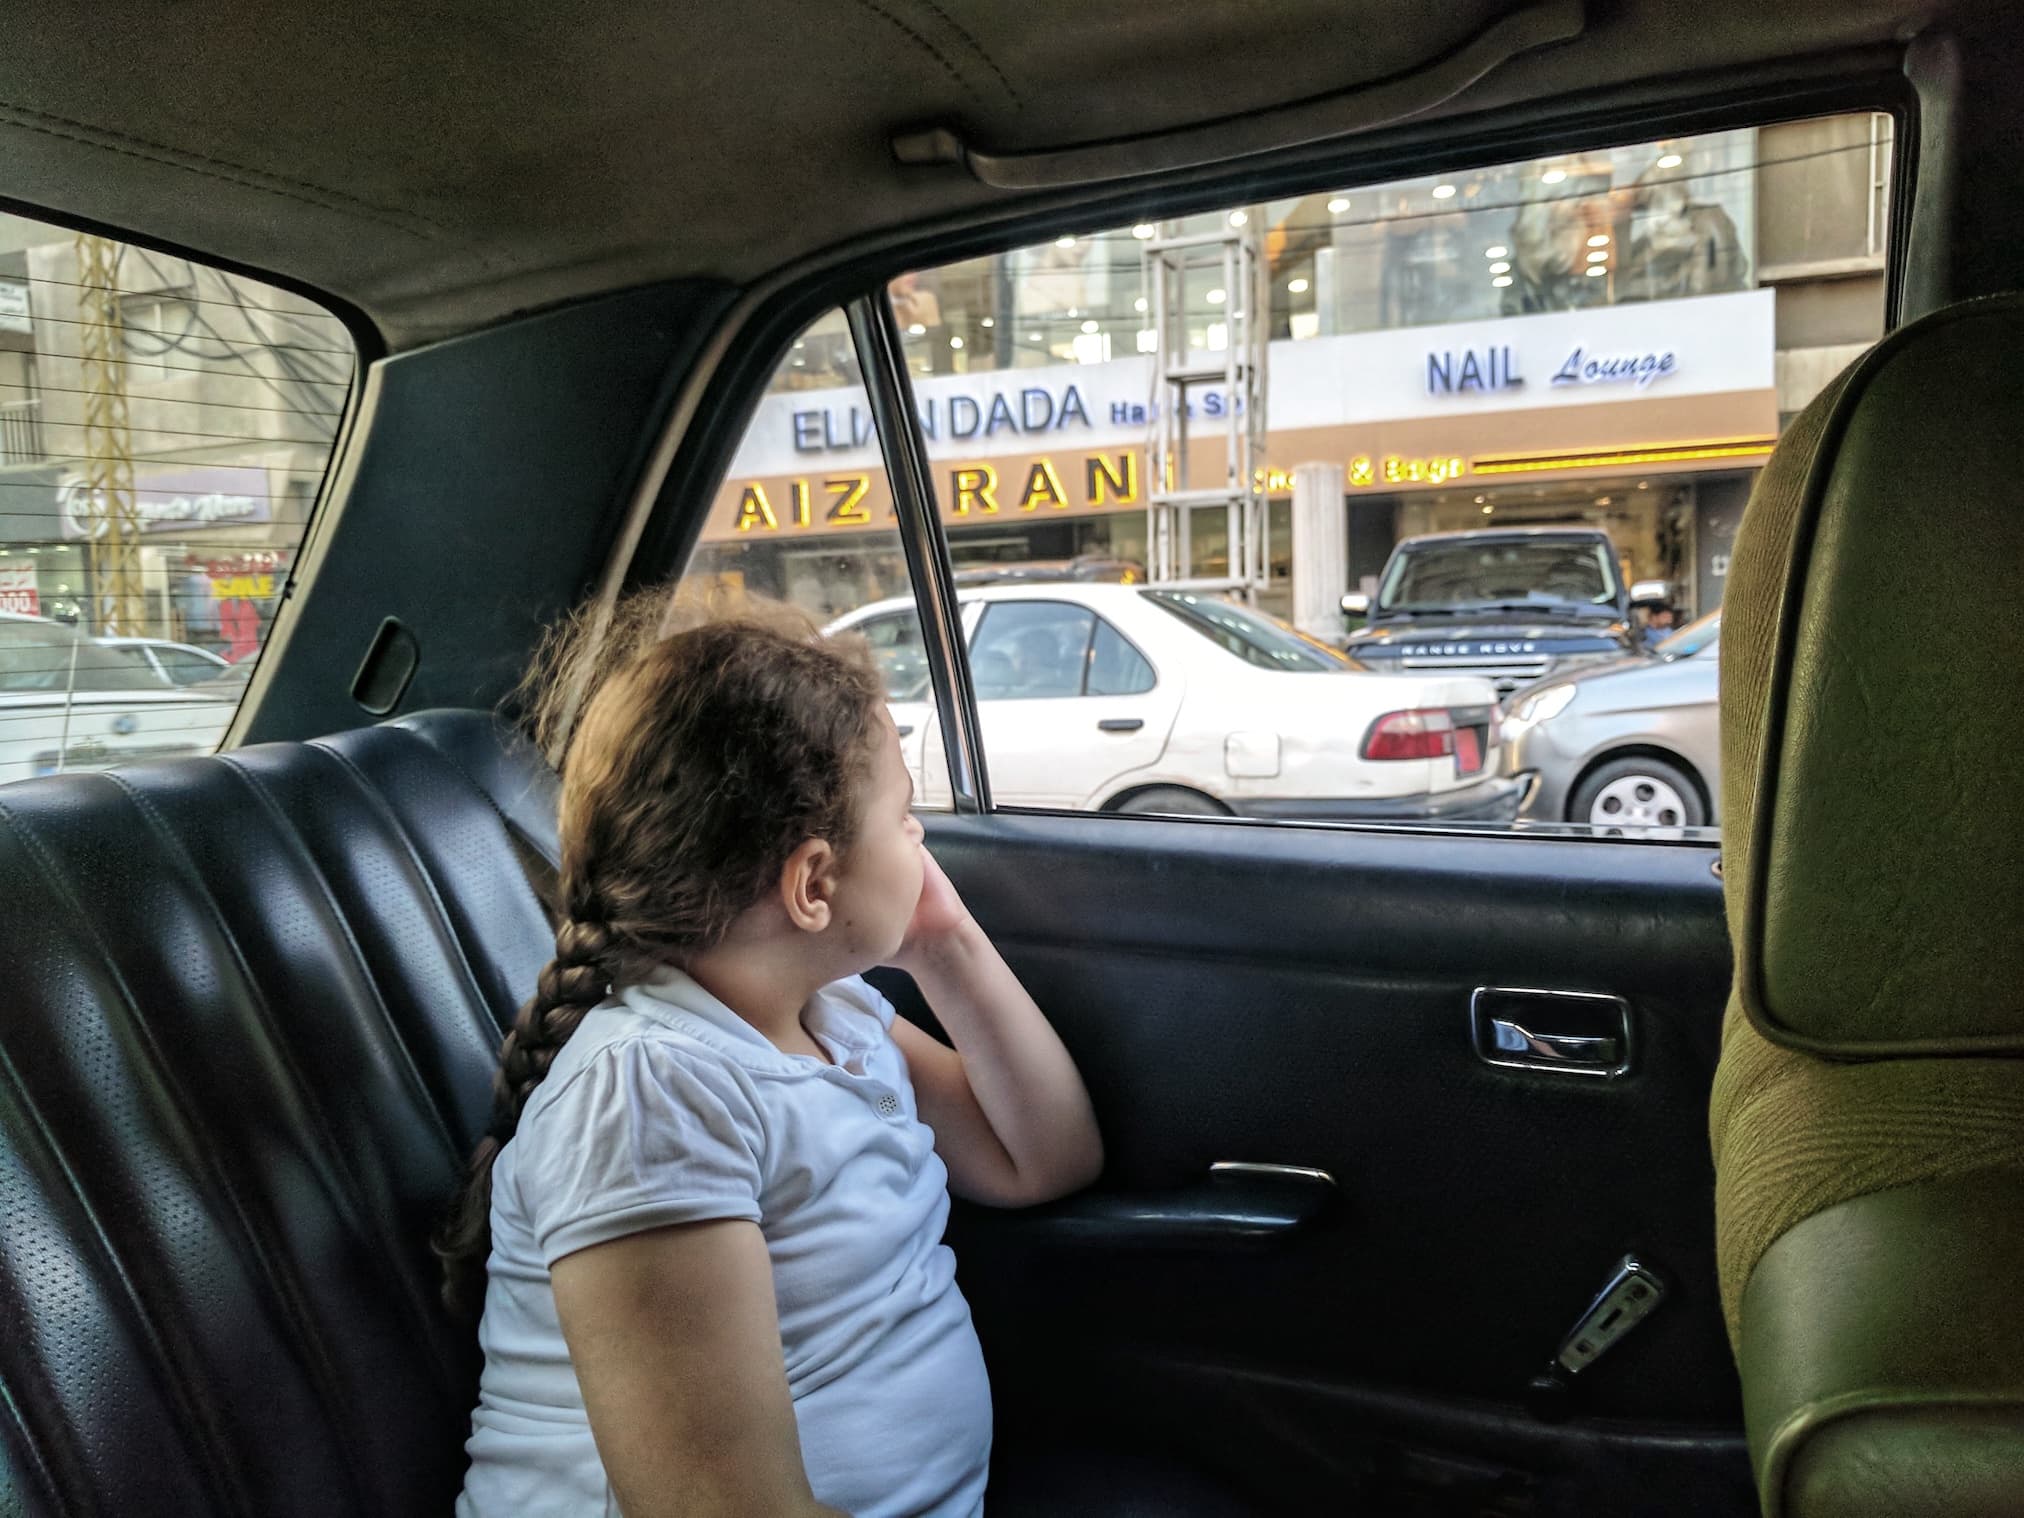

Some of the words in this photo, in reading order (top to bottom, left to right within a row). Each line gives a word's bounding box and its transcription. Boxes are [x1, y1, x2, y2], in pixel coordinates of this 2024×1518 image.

[1427, 345, 1524, 394] NAIL
[1551, 347, 1676, 384] Lounge
[949, 383, 1092, 438] DADA
[734, 451, 1175, 533] AIZRAN
[1350, 456, 1374, 487] &
[1384, 455, 1464, 485] Bags
[1401, 643, 1470, 656] RANGE
